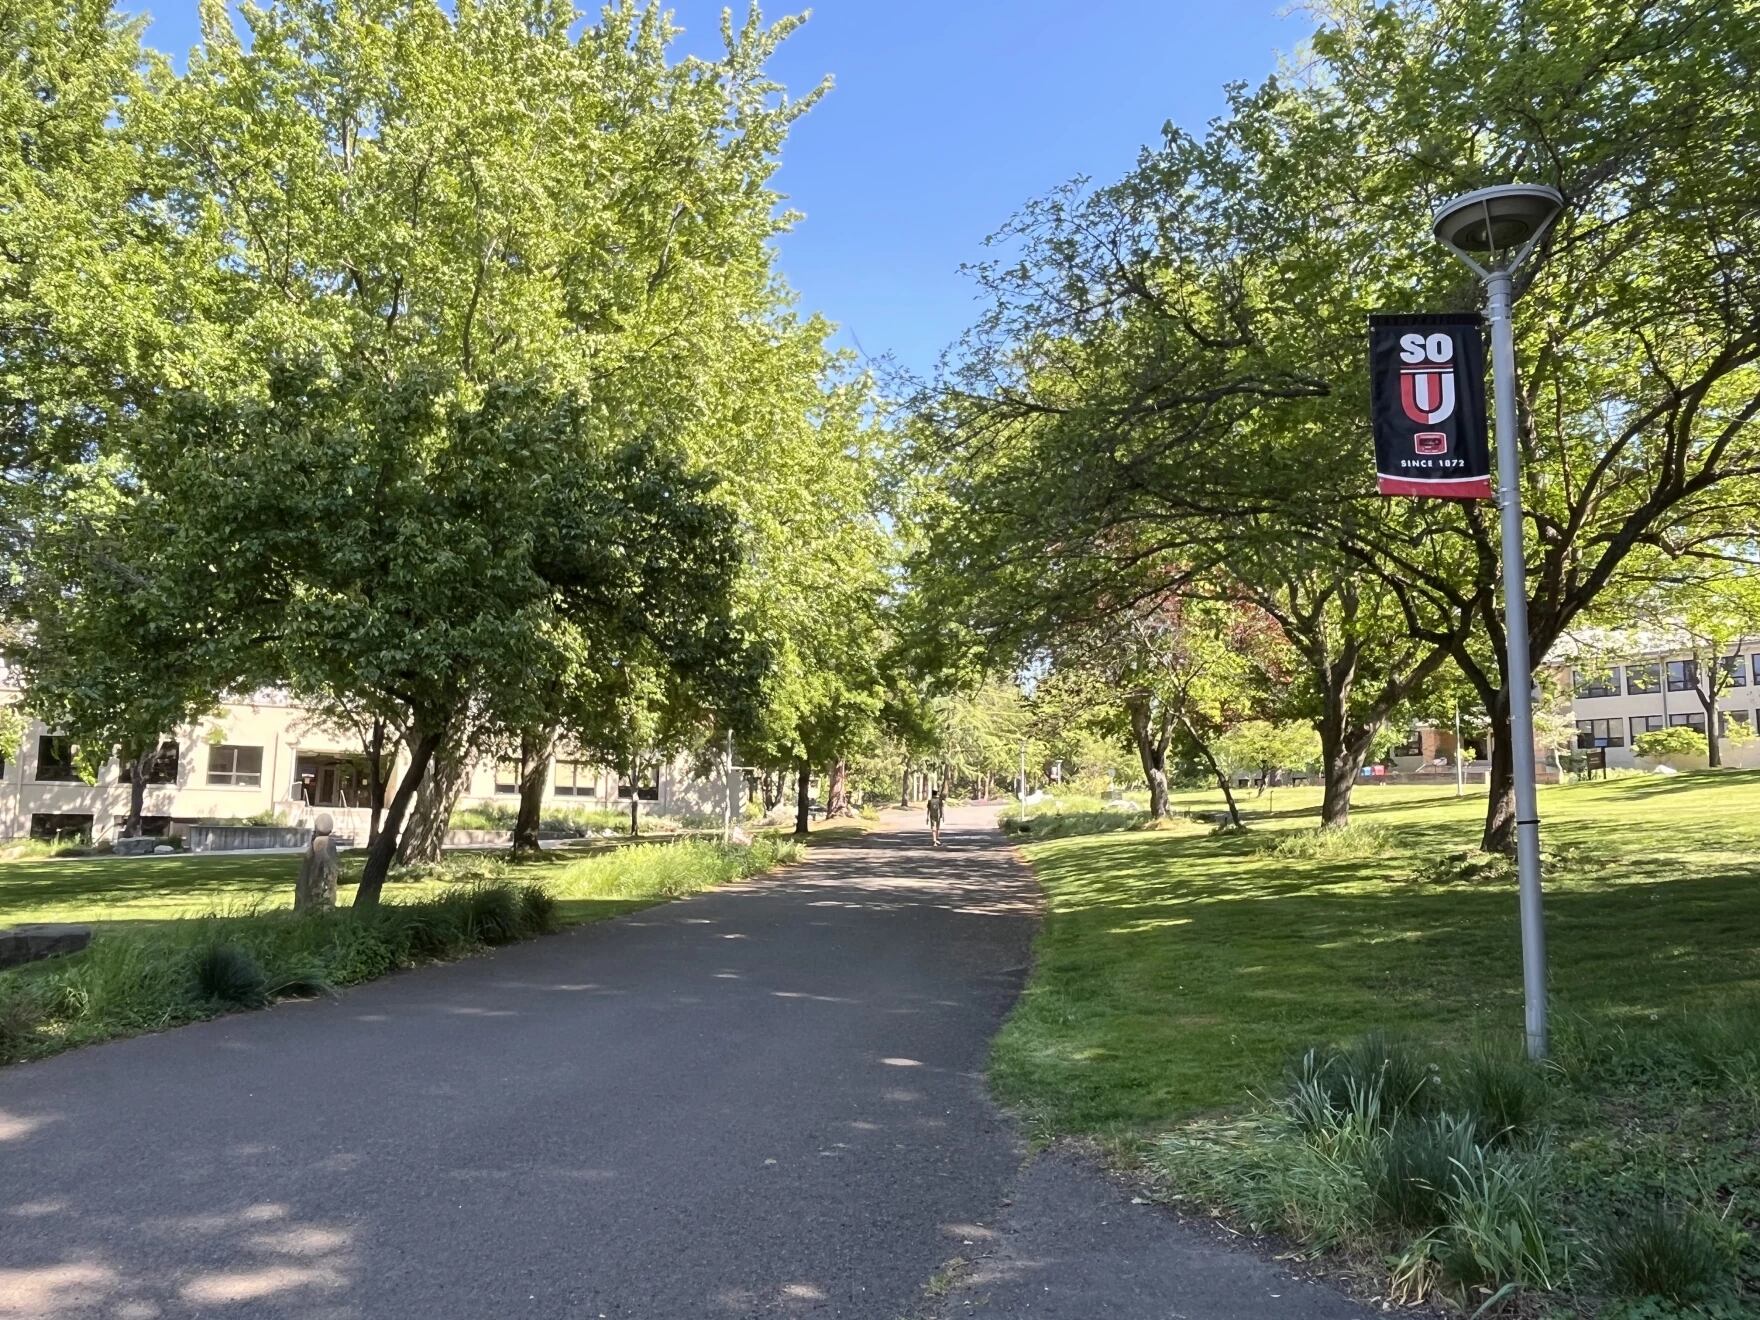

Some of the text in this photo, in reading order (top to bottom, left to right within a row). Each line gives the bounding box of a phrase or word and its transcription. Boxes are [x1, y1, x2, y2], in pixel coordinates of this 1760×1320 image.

[1400, 333, 1453, 363] SO
[1401, 372, 1456, 425] U
[1400, 459, 1465, 467] SINCE 1872
